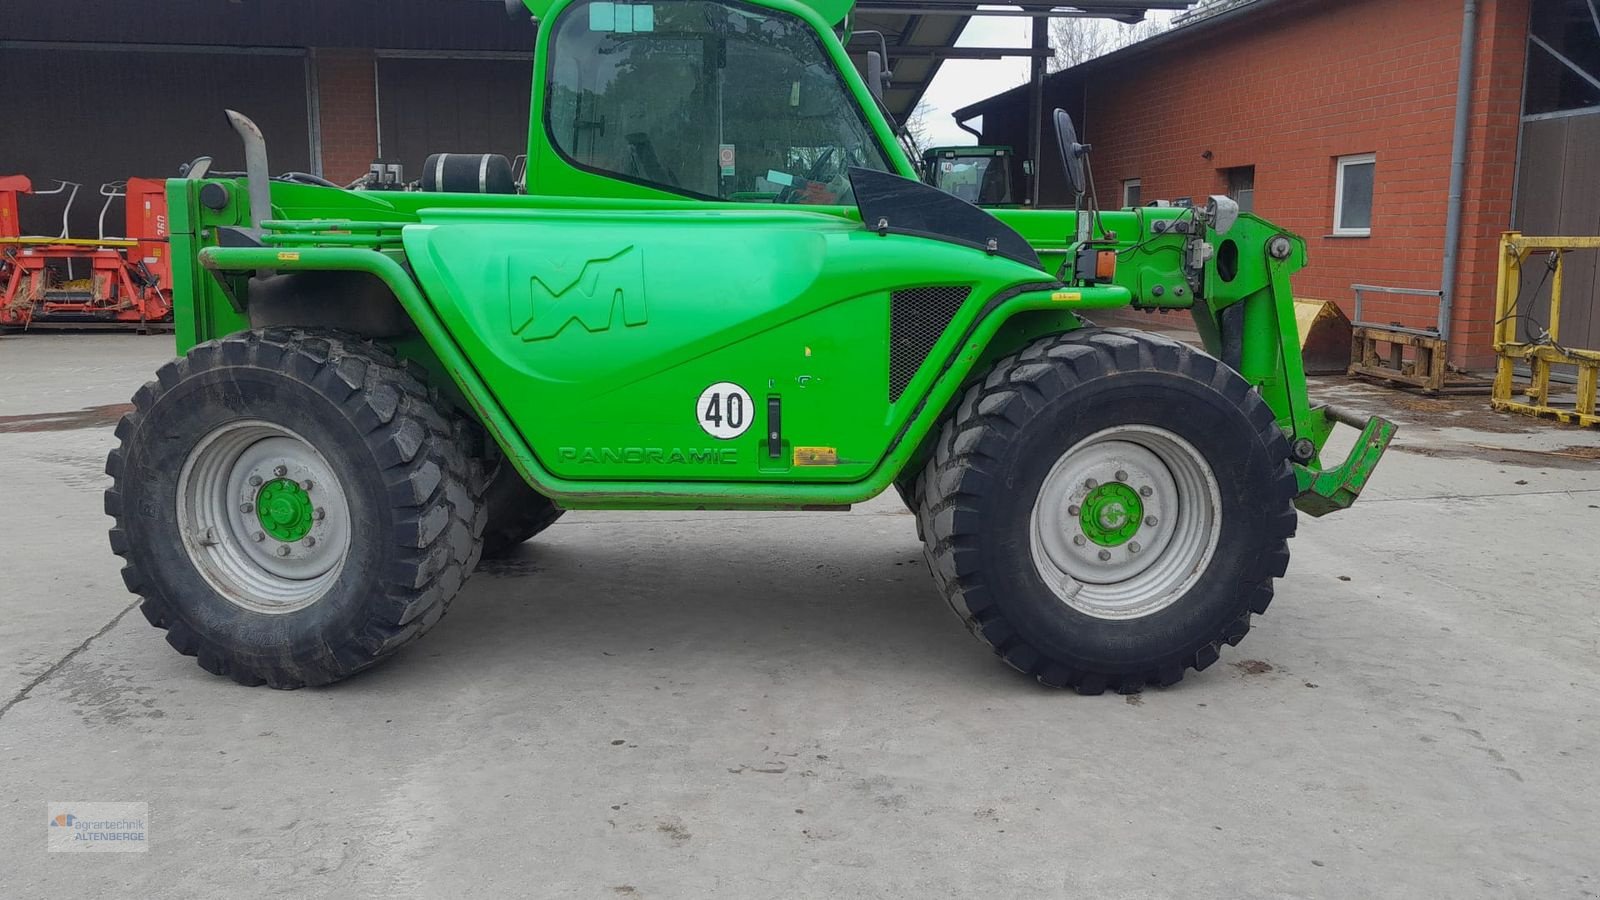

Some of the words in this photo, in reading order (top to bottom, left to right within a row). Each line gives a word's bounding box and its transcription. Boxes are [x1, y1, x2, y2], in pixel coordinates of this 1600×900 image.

[156, 215, 165, 236] 360
[705, 392, 743, 428] 40
[558, 447, 737, 465] PANORAMIC
